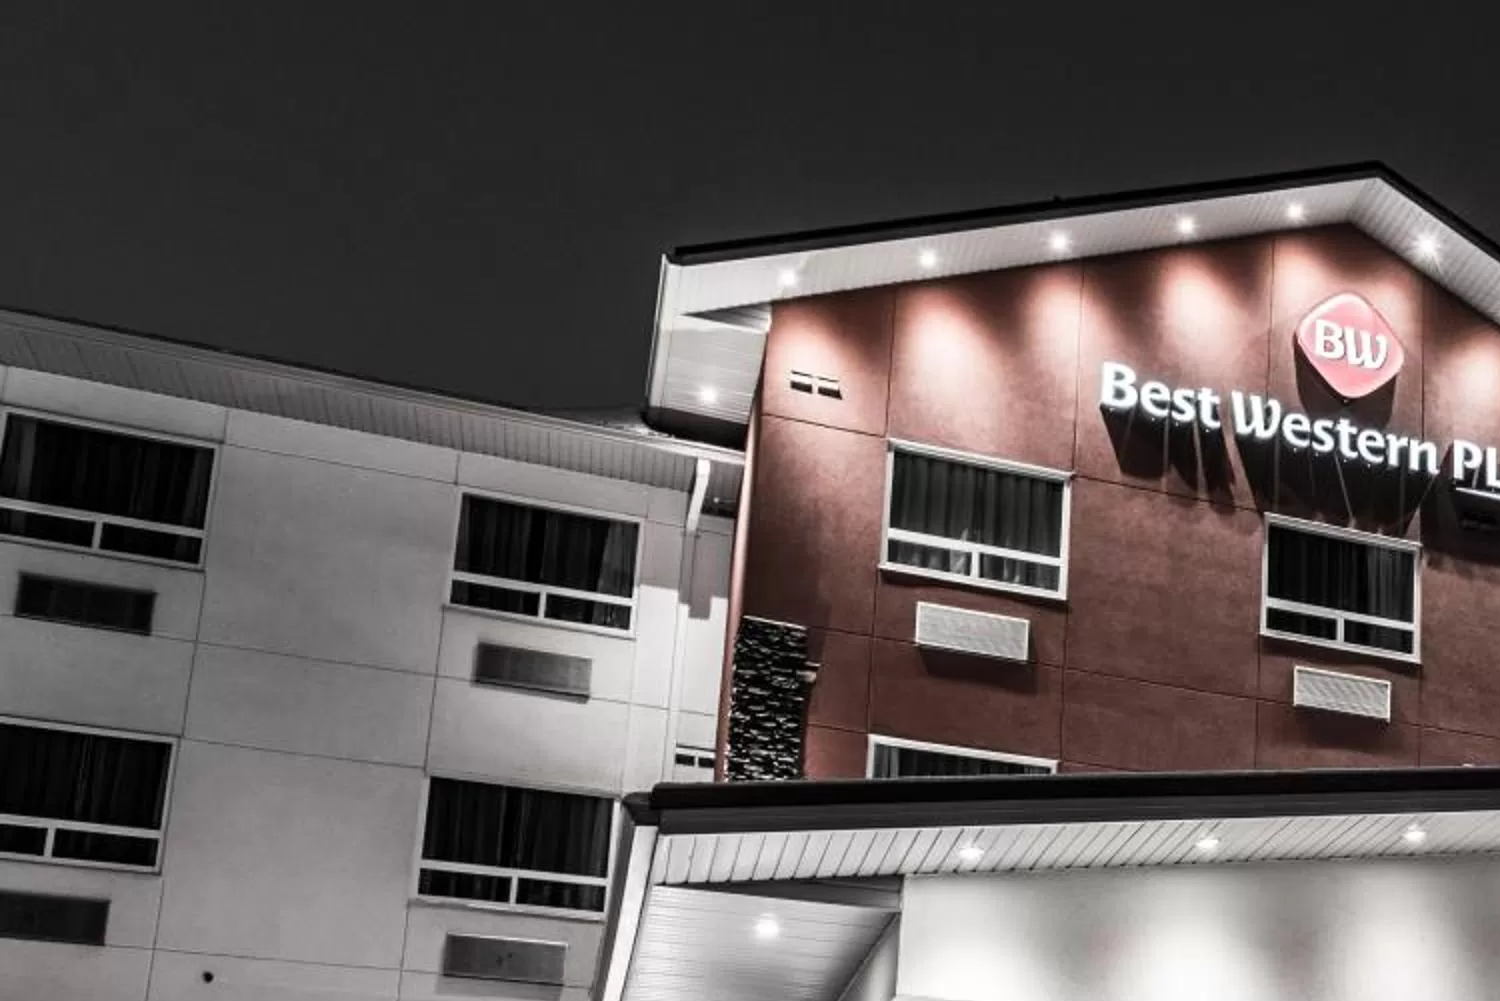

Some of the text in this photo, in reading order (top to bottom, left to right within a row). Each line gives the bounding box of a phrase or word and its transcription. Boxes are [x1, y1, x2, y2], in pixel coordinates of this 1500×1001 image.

[1313, 319, 1388, 370] BW
[1100, 361, 1222, 428] Best
[1230, 390, 1440, 475] Western
